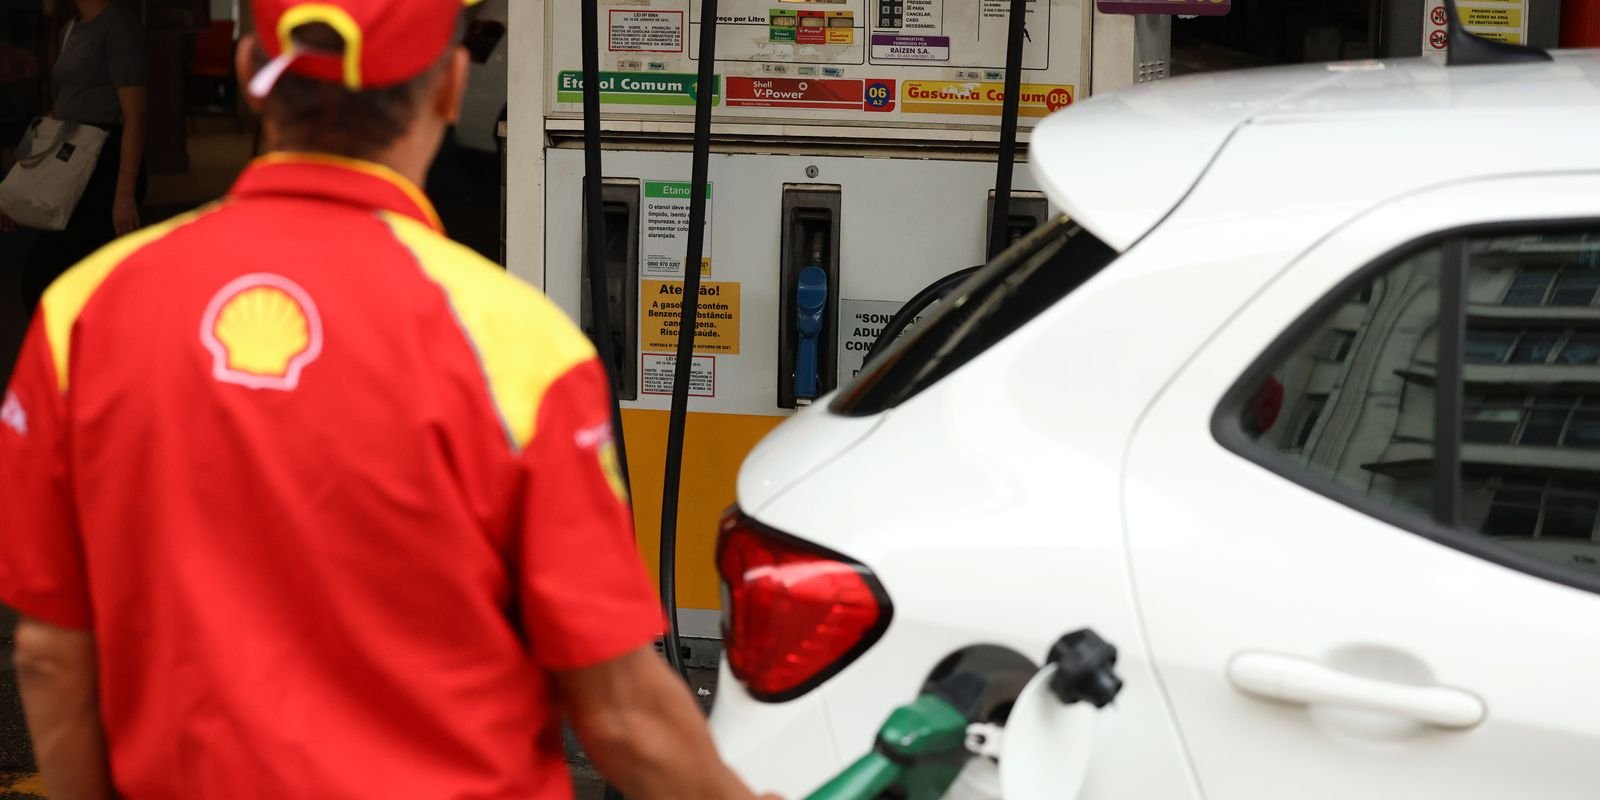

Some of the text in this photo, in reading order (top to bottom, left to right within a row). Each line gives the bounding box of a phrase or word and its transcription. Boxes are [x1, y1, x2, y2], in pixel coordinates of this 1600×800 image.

[563, 77, 613, 89] Etaol
[621, 78, 682, 91] Comum
[753, 88, 803, 99] V-Power
[869, 88, 886, 98] 06
[987, 90, 1045, 102] Coum
[1050, 94, 1068, 104] 08
[663, 186, 690, 195] Etano
[660, 284, 720, 296] Ateão!
